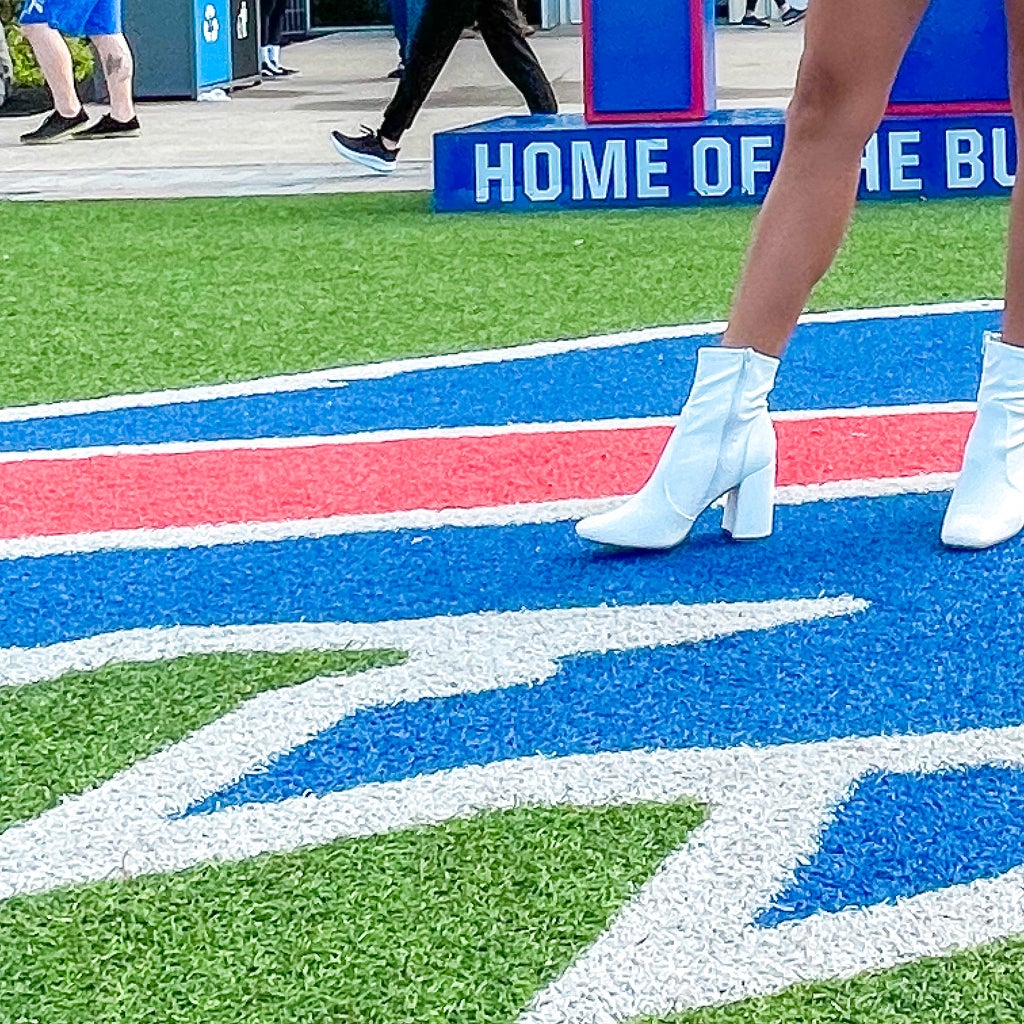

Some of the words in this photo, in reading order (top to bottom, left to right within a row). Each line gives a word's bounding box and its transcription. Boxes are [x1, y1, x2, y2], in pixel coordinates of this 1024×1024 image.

[475, 139, 670, 204] HOME
[692, 136, 772, 197] OF
[860, 130, 923, 192] HE
